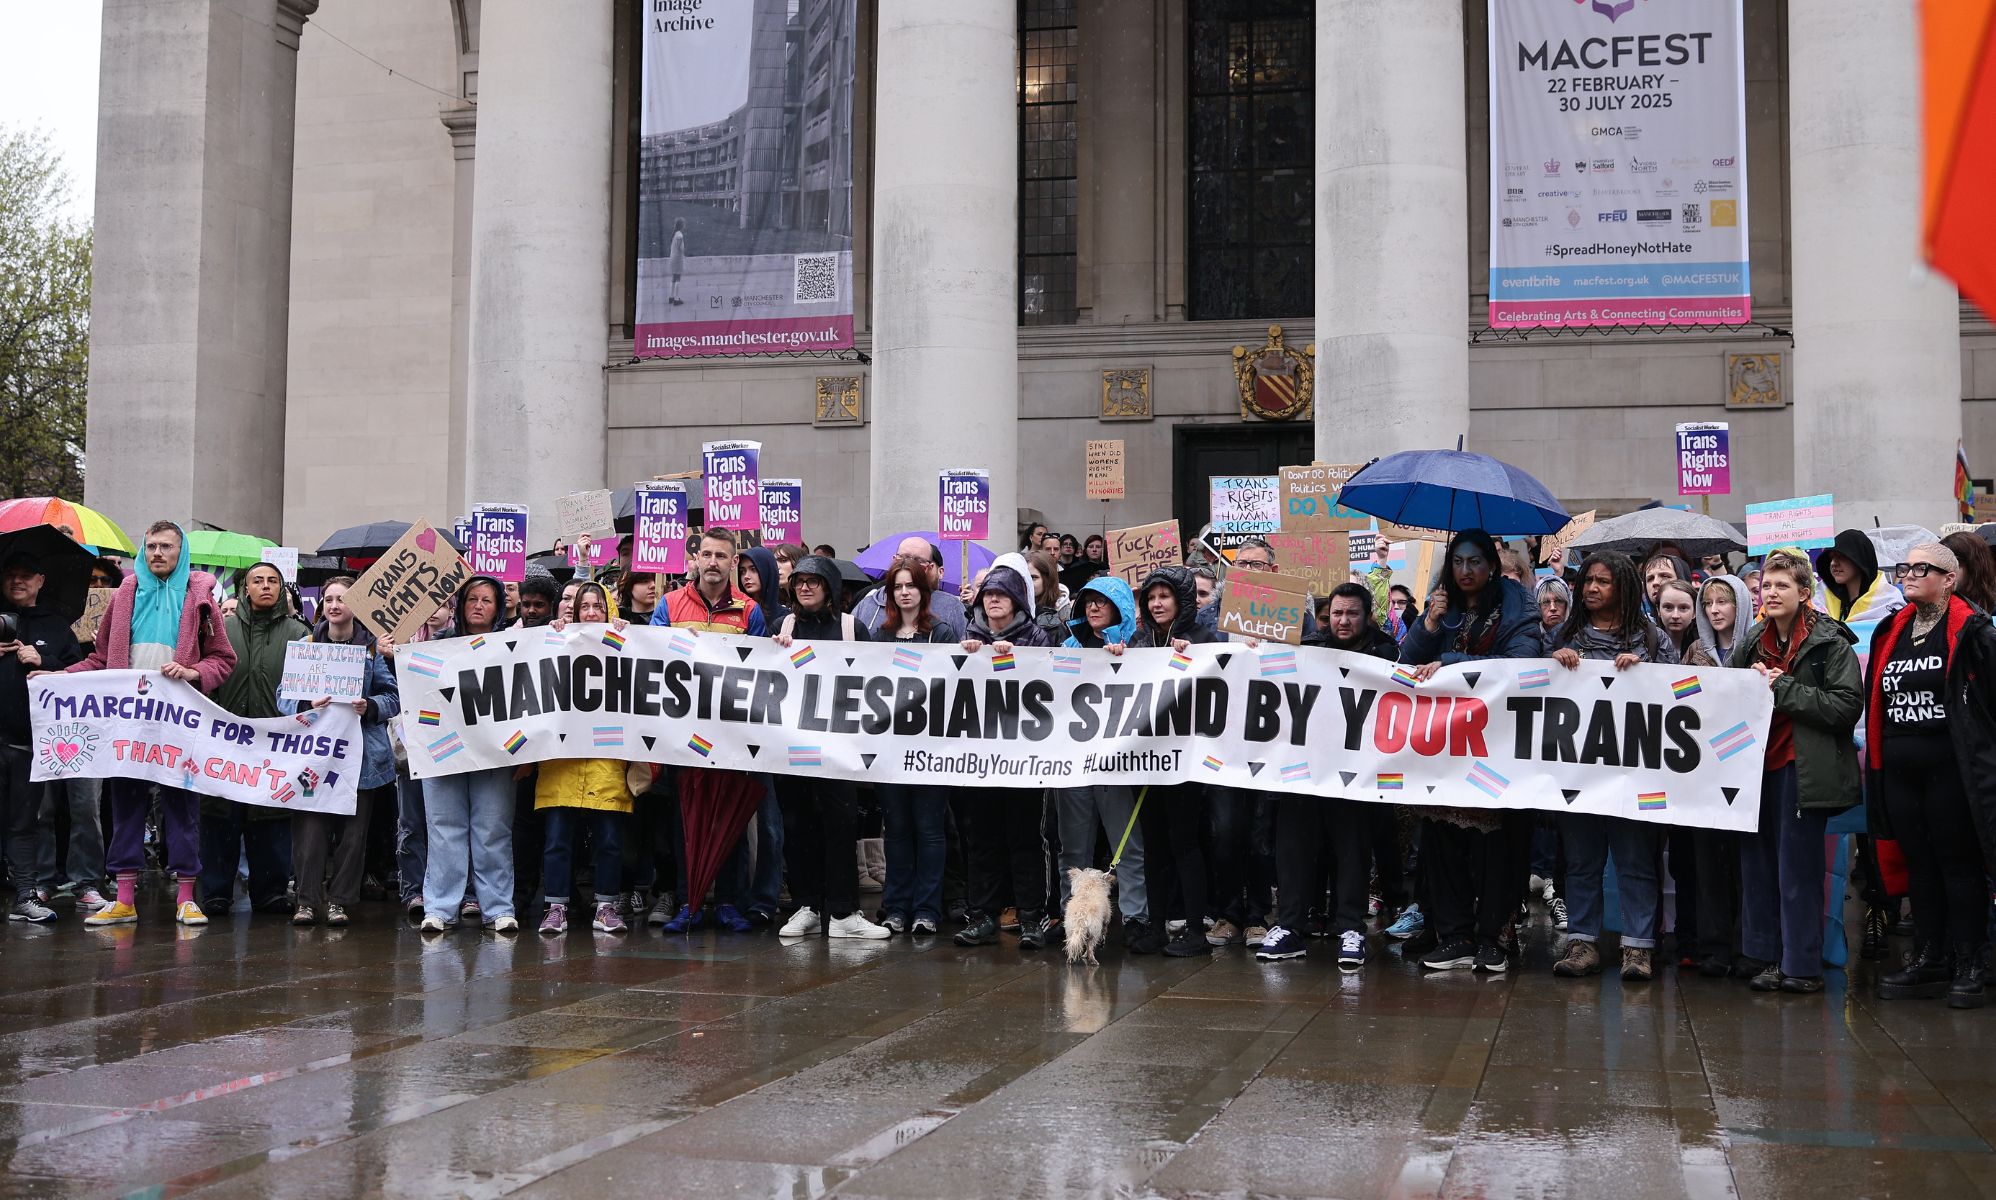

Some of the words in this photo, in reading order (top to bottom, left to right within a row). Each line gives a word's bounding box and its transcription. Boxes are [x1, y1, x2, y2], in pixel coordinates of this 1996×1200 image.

[653, 0, 702, 15] Image
[653, 15, 714, 34] Archive
[1518, 32, 1713, 72] MACFEST
[1548, 78, 1567, 93] 22
[1572, 74, 1665, 92] FEBRUARY
[1559, 97, 1581, 112] 30
[1585, 95, 1626, 111] JULY
[1630, 93, 1673, 109] 2025
[1591, 127, 1623, 136] GMCA
[1545, 242, 1693, 259] #SpreadHoneyNotHate
[1502, 275, 1561, 288] eventbrite
[1573, 275, 1649, 288] macfest.org.uk
[1661, 273, 1740, 286] @MACFESTUK
[1498, 310, 1561, 322] Celebrating
[1563, 309, 1587, 320] Arts
[1590, 309, 1599, 320] &
[1601, 308, 1666, 320] Connecting
[1668, 306, 1742, 319] Communities
[647, 327, 840, 351] images.manchester.gov.uk
[1089, 442, 1114, 450] SINCE
[1678, 432, 1718, 450] Trans
[705, 452, 746, 475] Trans
[1681, 450, 1727, 473] Rights
[1327, 467, 1357, 479] Politi
[1682, 470, 1713, 488] Now
[708, 475, 756, 502] Rights
[941, 477, 979, 495] Trans
[1223, 477, 1269, 489] TRANS
[638, 492, 678, 515] Trans
[758, 487, 791, 504] Trans
[1227, 488, 1273, 503] RIGHTS
[708, 499, 742, 522] Now
[760, 505, 799, 526] Rights
[943, 495, 987, 517] Rights
[1236, 501, 1261, 512] ARE
[1288, 497, 1317, 516] DO
[474, 513, 515, 533] Trans
[943, 514, 972, 532] Now
[1221, 511, 1269, 521] HUMAN
[1763, 512, 1785, 520] TRANS
[1782, 520, 1796, 530] ARE
[639, 516, 685, 544] Rights
[761, 523, 785, 541] Now
[1226, 521, 1273, 533] RIGHTS
[1765, 532, 1789, 542] HUMAN
[1791, 529, 1813, 538] RIGHTS
[476, 532, 524, 557] Rights
[572, 543, 602, 558] Nw
[637, 540, 668, 563] Now
[1116, 532, 1154, 559] FUCK
[1348, 538, 1366, 546] ANS
[475, 553, 507, 573] Now
[1139, 545, 1179, 562] THOSE
[367, 548, 418, 600] TRANS
[1223, 611, 1299, 640] Matter
[288, 642, 323, 661] TRANS
[326, 645, 366, 664] RIGHTS
[309, 663, 328, 674] ARE
[1884, 655, 1943, 675] STAND
[282, 672, 320, 694] HUMAN
[324, 674, 364, 697] RIGHTS
[1882, 675, 1903, 692] BY
[1886, 690, 1935, 706] YOUR
[458, 654, 789, 727] MANCHESTER
[797, 673, 1055, 742] LESBIANS
[1068, 675, 1230, 743] STAND
[1243, 679, 1322, 747] BY
[1338, 686, 1489, 758] YOUR
[1506, 696, 1702, 774] TRANS
[1887, 704, 1947, 723] TRANS
[210, 719, 256, 746] FOR
[267, 731, 349, 760] THOSE
[112, 739, 183, 769] THAT
[903, 749, 1073, 779] #StandByYourTrans
